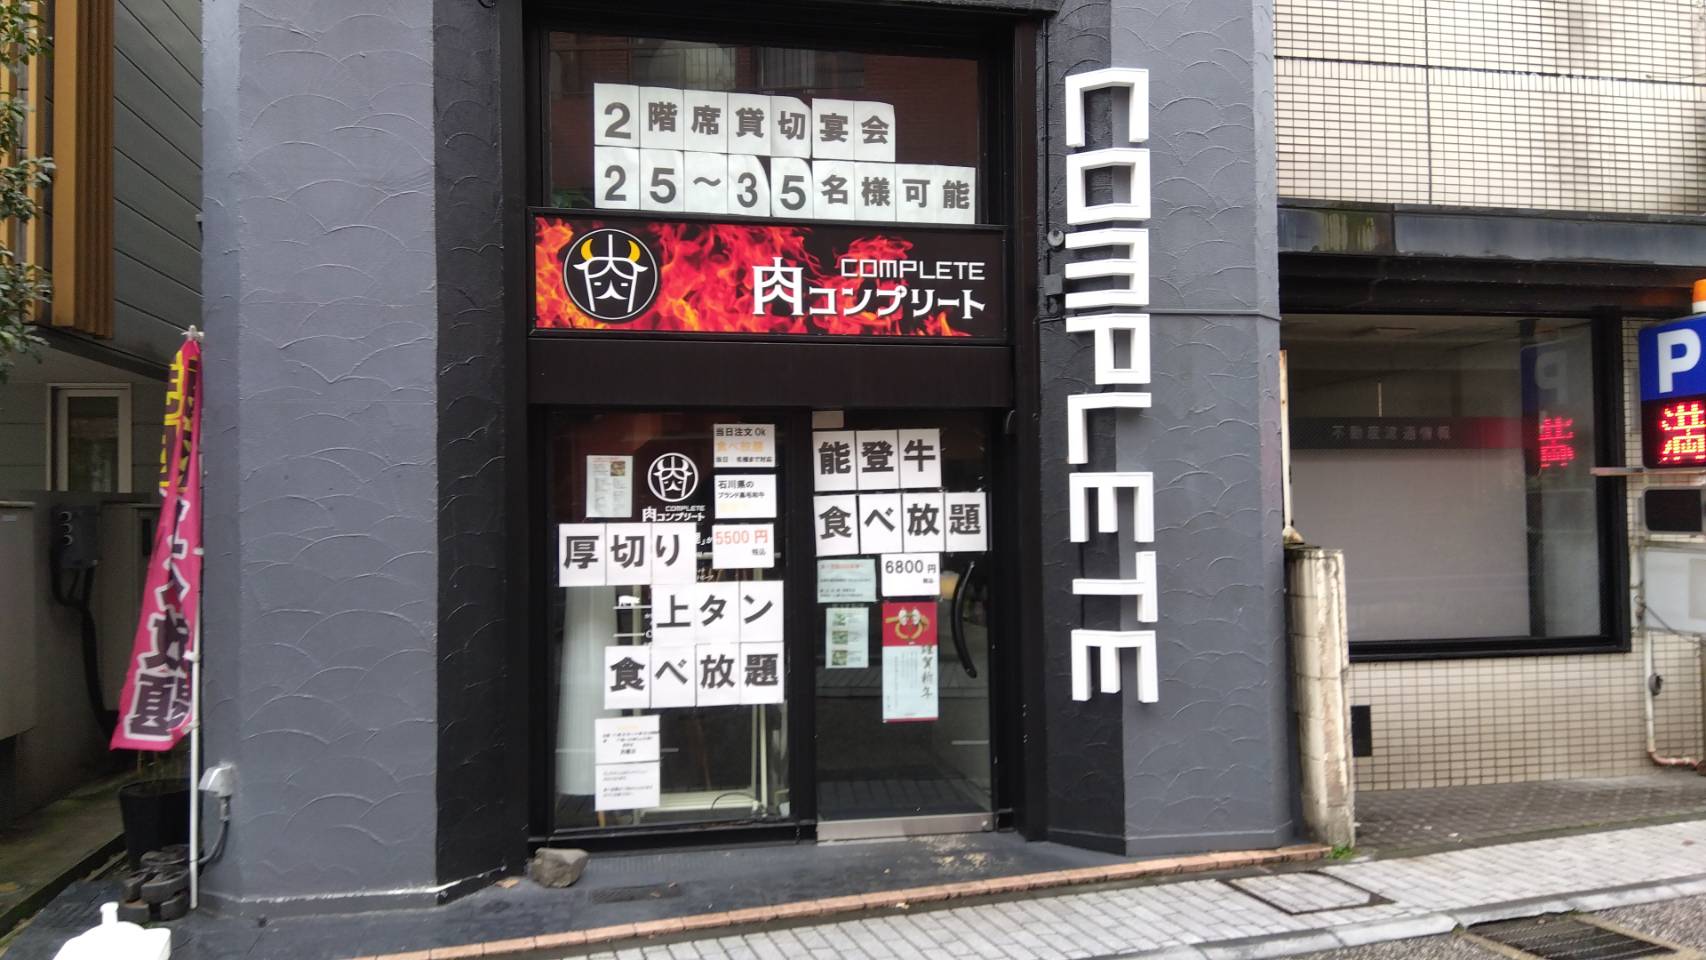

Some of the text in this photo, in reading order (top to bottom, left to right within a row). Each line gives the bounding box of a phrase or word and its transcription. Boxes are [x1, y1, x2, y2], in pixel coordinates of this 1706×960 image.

[604, 101, 889, 144] 2階席貸切宴会
[841, 258, 985, 281] COMPLETE
[752, 256, 986, 320] 肉コンプリート
[1657, 328, 1701, 393] P
[1065, 68, 1158, 703] COMPLETE
[716, 427, 753, 437] 当日注文
[1661, 402, 1706, 461] 満
[818, 439, 936, 475] 能登牛
[718, 480, 754, 489] 石川県の
[642, 506, 706, 522] 肉コンプリート
[818, 503, 981, 540] 食べ放題
[563, 534, 680, 569] 厚切り
[656, 594, 773, 628] 上タン
[609, 653, 779, 692] 食べ放題
